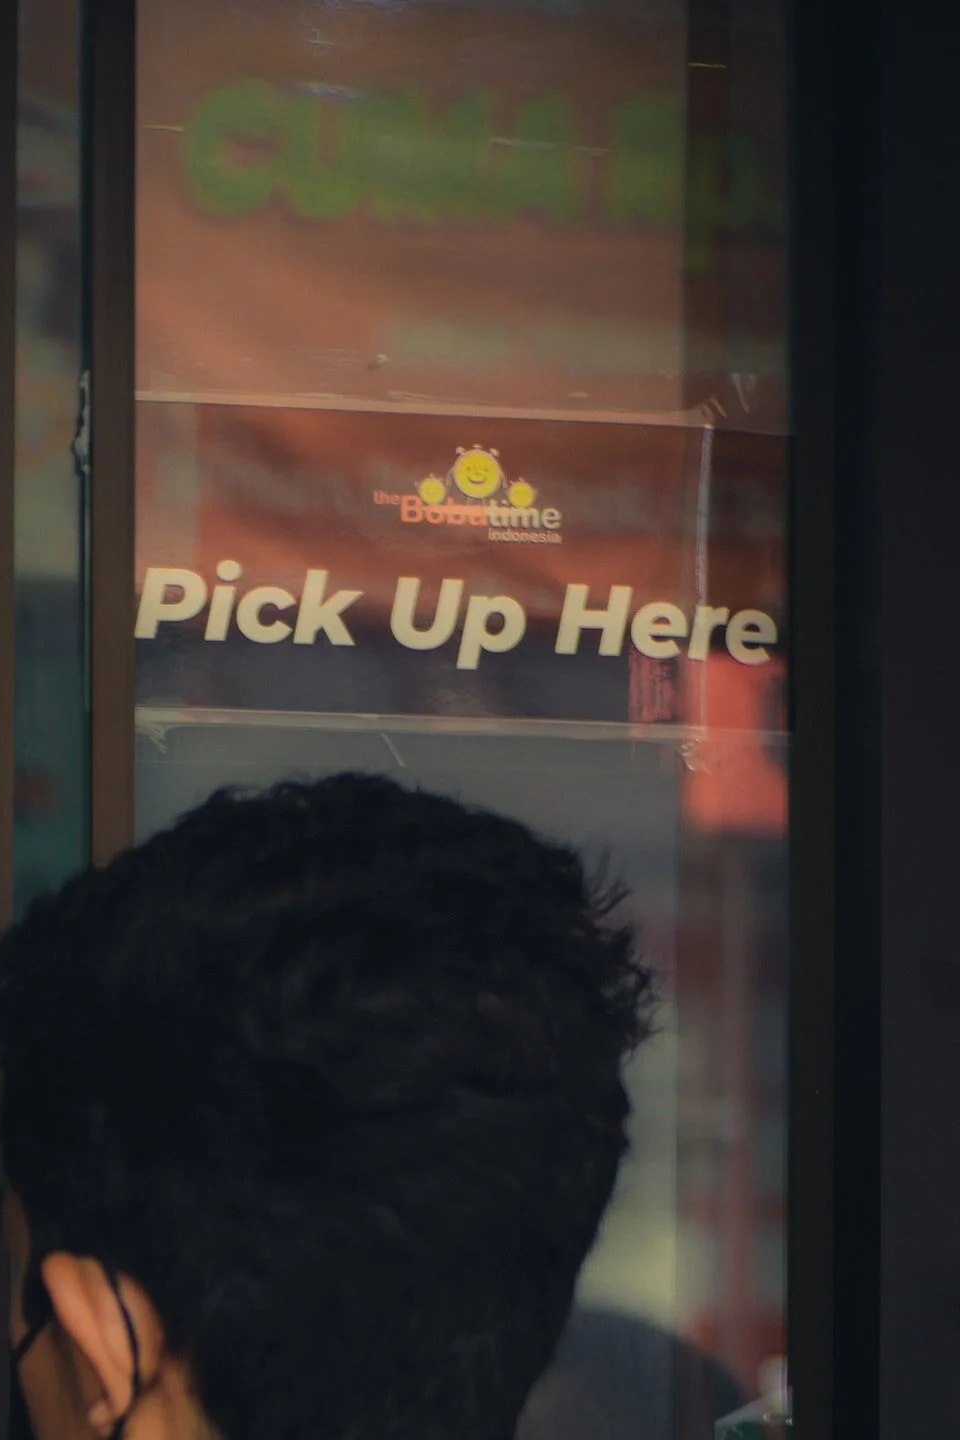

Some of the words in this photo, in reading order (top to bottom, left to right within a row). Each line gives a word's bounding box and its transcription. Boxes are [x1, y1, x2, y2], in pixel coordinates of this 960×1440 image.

[488, 527, 562, 545] indonesia
[135, 559, 363, 647] Pick
[390, 576, 527, 670] Up
[554, 583, 778, 666] Here
